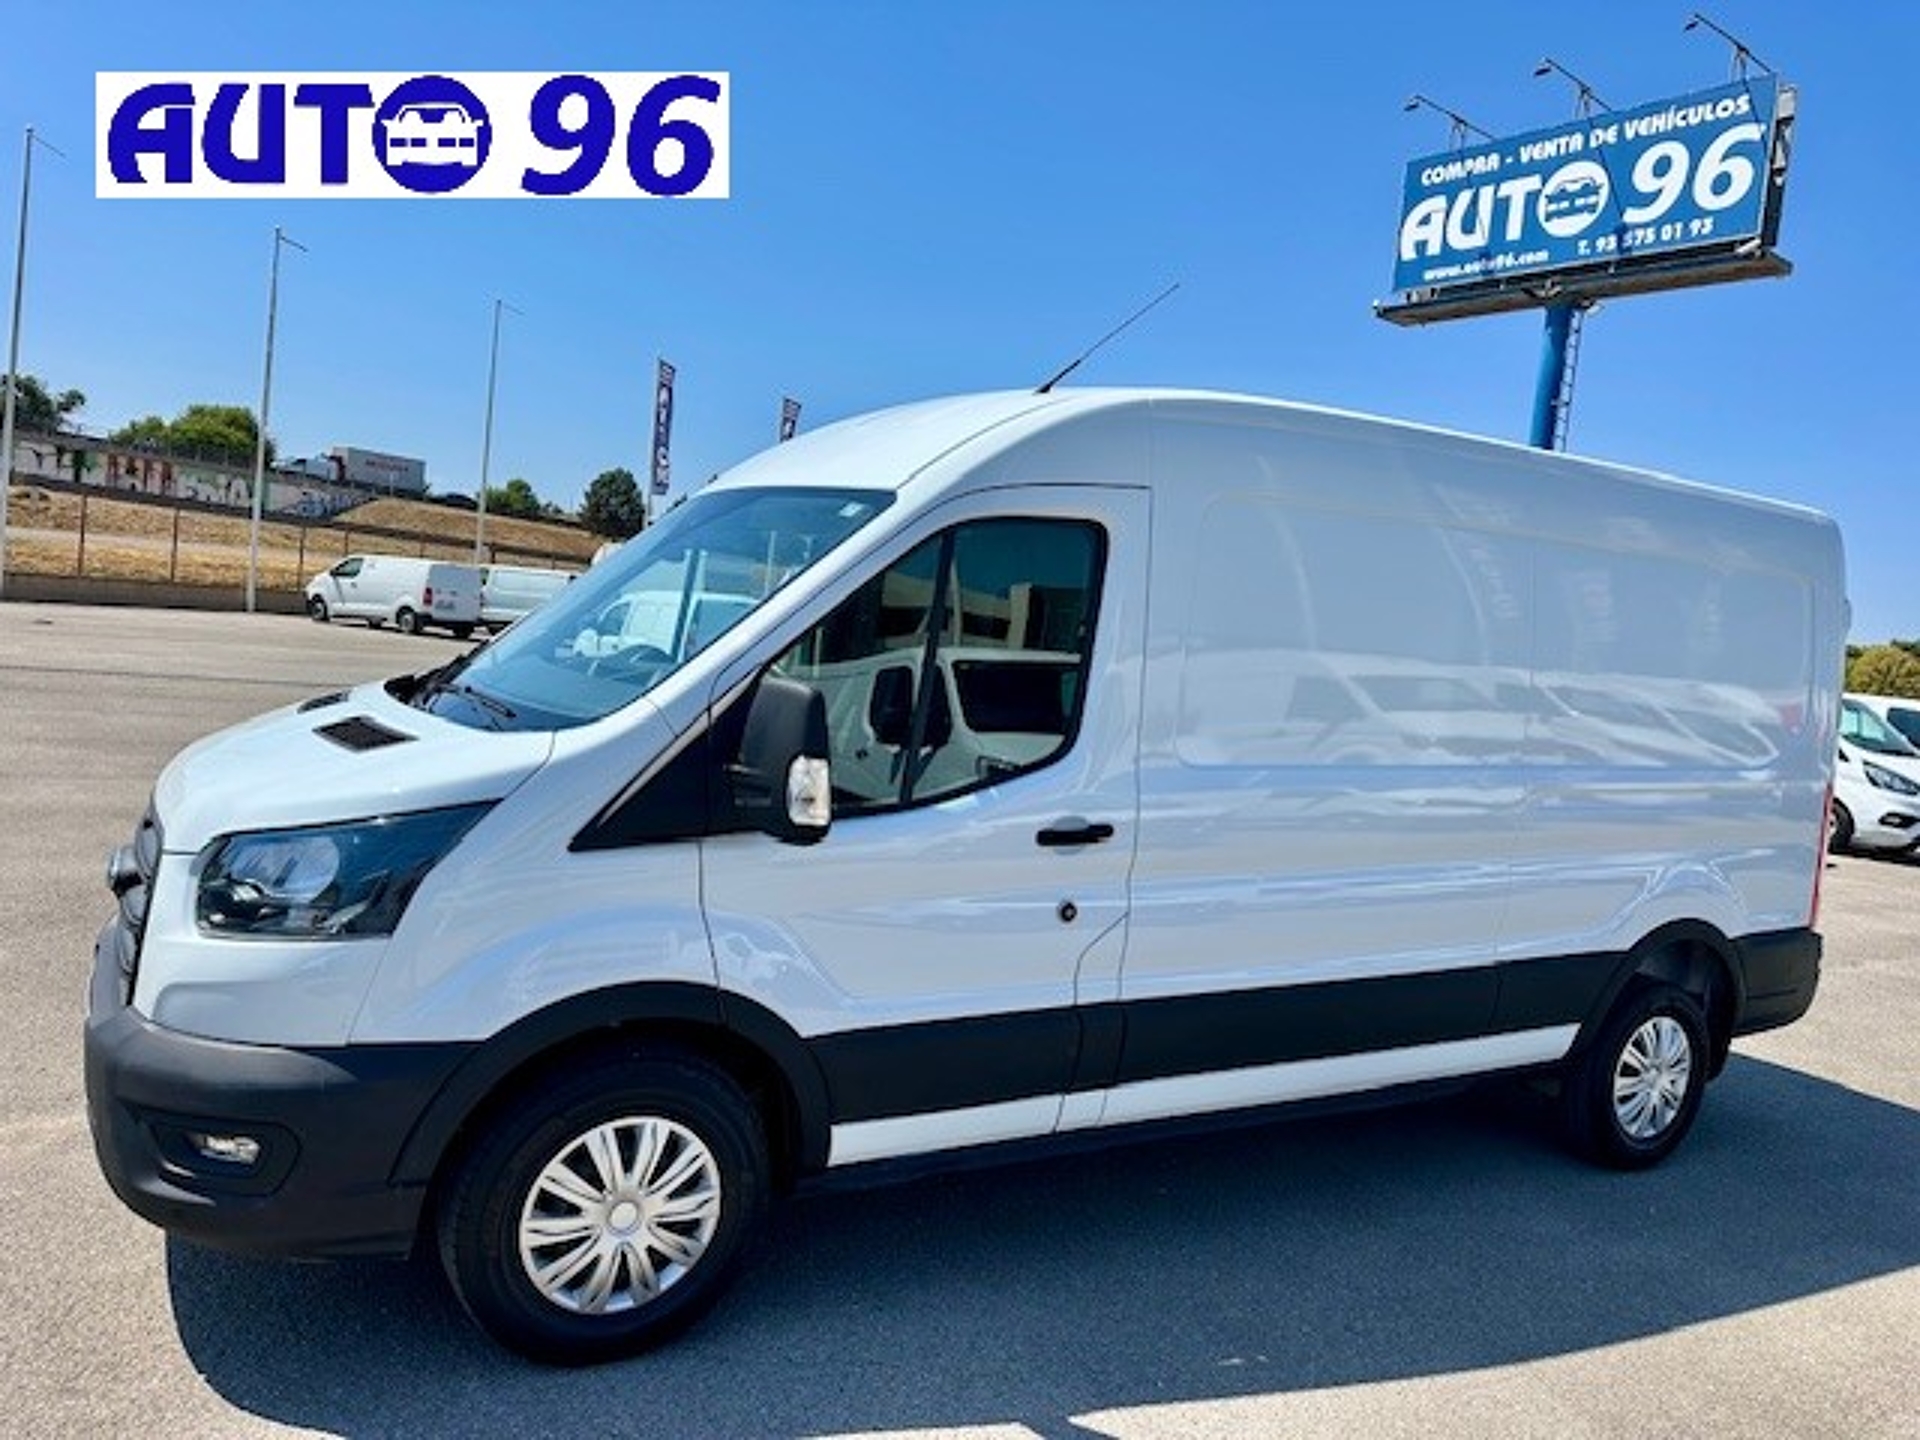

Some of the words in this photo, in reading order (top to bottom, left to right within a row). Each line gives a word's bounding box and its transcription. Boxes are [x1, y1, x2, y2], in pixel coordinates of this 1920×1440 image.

[1400, 160, 1610, 261] AUTO
[1622, 121, 1767, 226] 96
[1420, 156, 1499, 187] COMPRA
[1519, 131, 1585, 163] VENTA
[1590, 118, 1618, 150] DE
[1625, 93, 1751, 141] VEHÍCULOS
